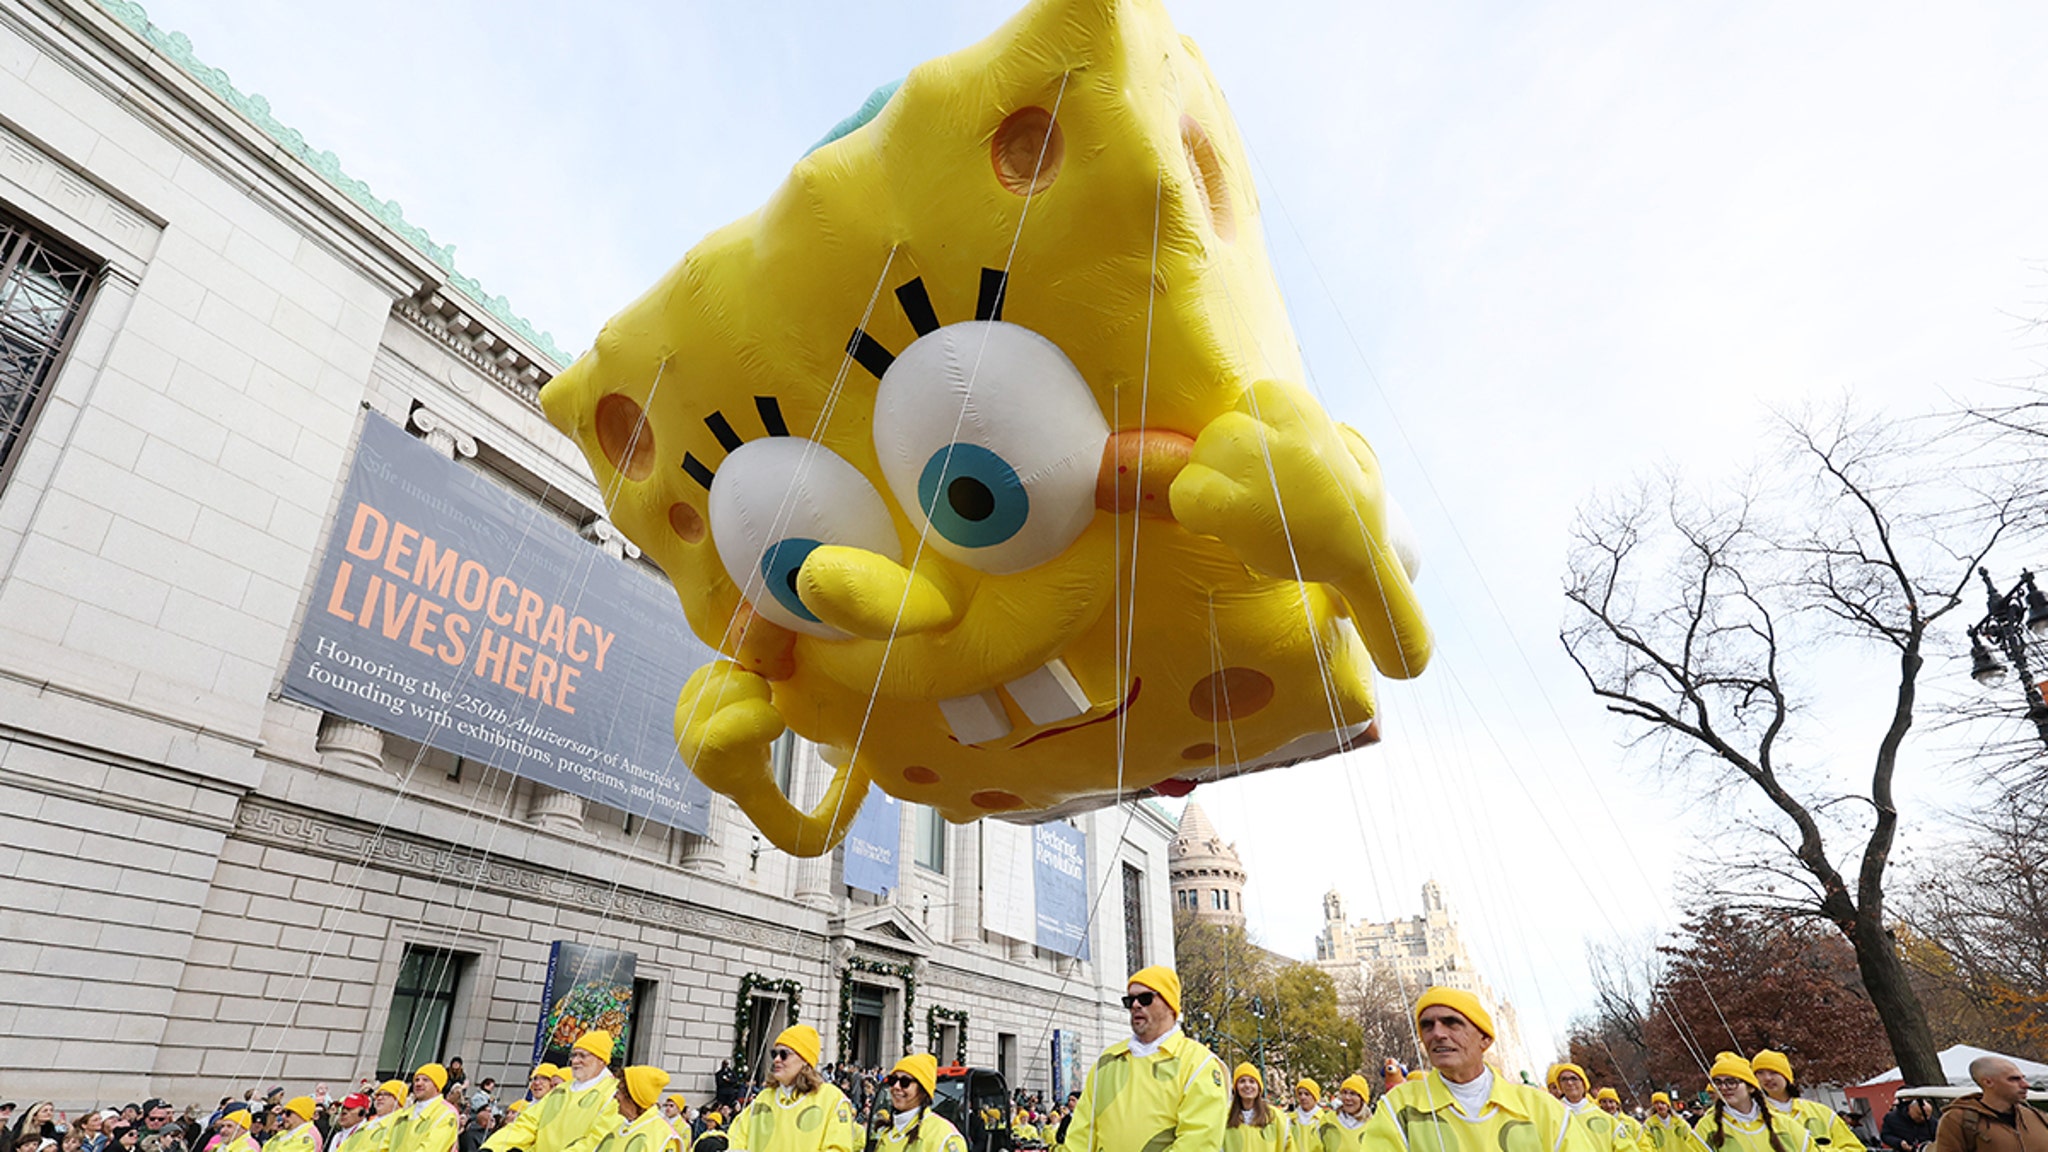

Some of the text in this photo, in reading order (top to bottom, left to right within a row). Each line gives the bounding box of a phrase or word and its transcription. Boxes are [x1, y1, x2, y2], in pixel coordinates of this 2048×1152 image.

[326, 560, 581, 714] LIVES HERE
[345, 501, 616, 672] DEMOCRACY
[307, 662, 692, 815] founding with exhibitions, programs, and more!
[315, 635, 681, 792] Honoring the 250th Anniversary of America's
[1035, 842, 1082, 881] Revolution
